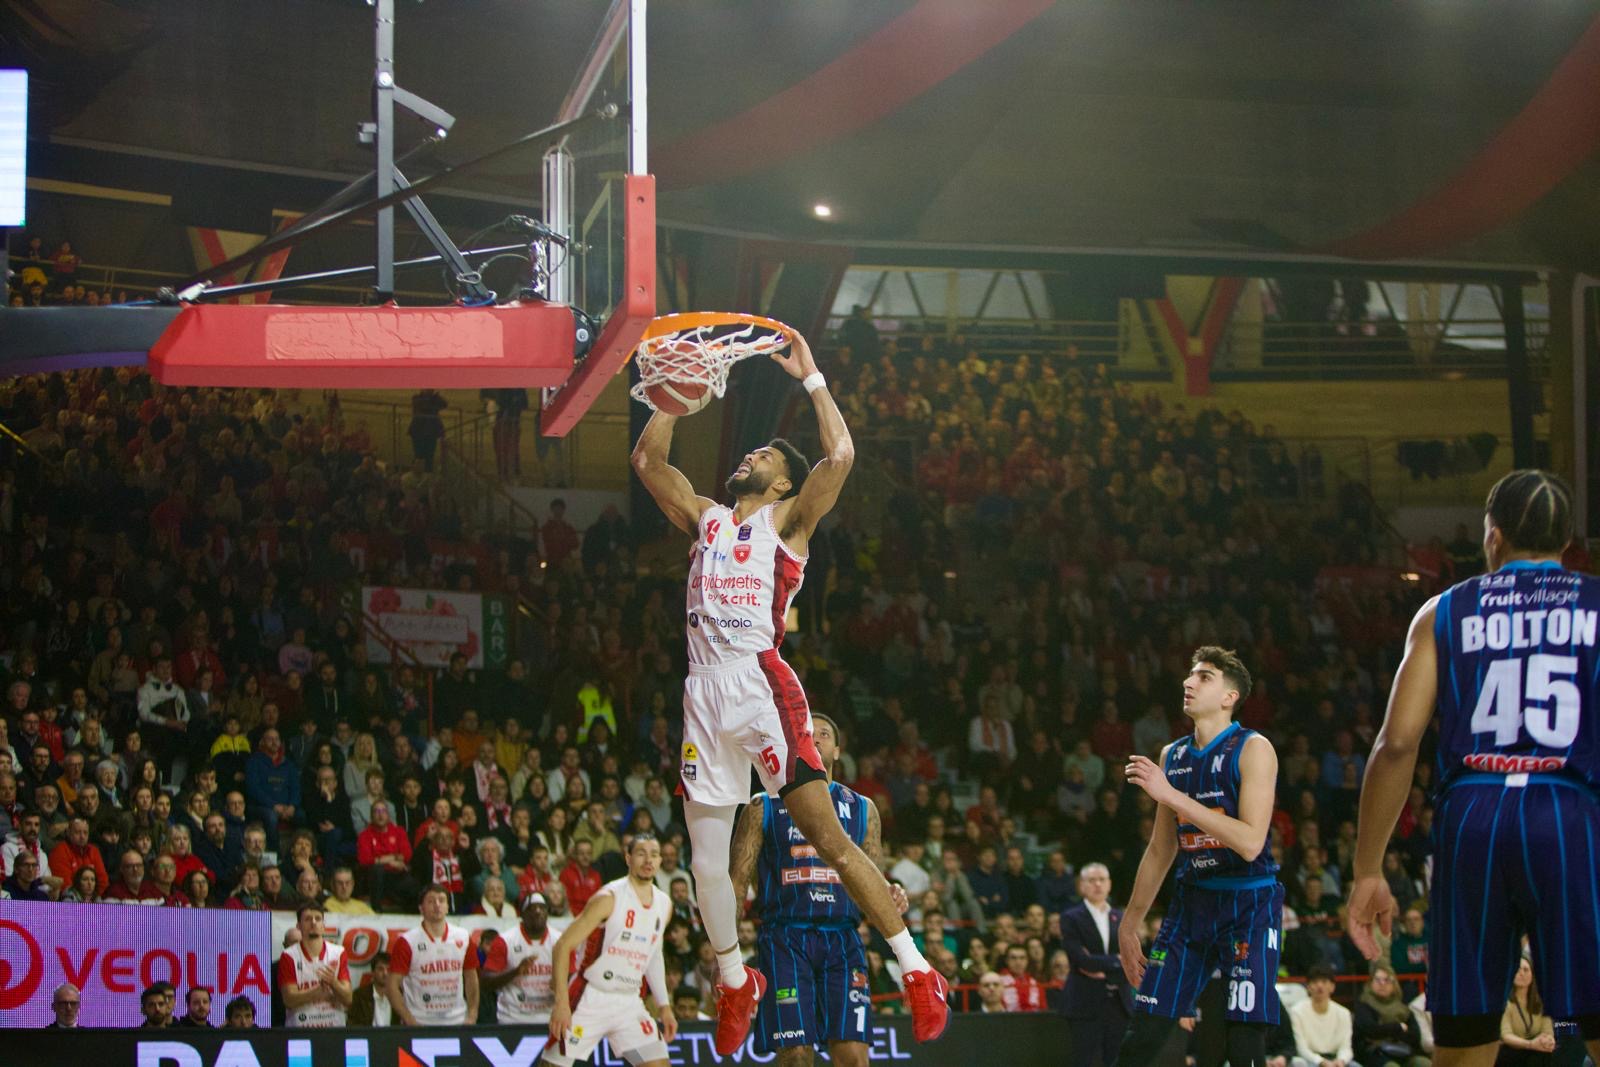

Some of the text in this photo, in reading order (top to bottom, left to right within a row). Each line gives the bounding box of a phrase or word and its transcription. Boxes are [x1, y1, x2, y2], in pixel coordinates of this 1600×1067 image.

[708, 594, 719, 602] by
[489, 600, 505, 650] BAR
[703, 616, 753, 628] motorola
[1461, 608, 1598, 653] BOLTON
[1471, 654, 1581, 749] 45
[1211, 754, 1225, 773] N
[1463, 754, 1567, 773] KIMBO
[837, 801, 852, 819] N
[625, 909, 636, 929] 8
[1268, 927, 1278, 950] N
[55, 946, 271, 995] VEOLIA
[1228, 980, 1256, 1012] 30
[854, 1005, 866, 1033] 1
[773, 1029, 806, 1040] GIVOVA
